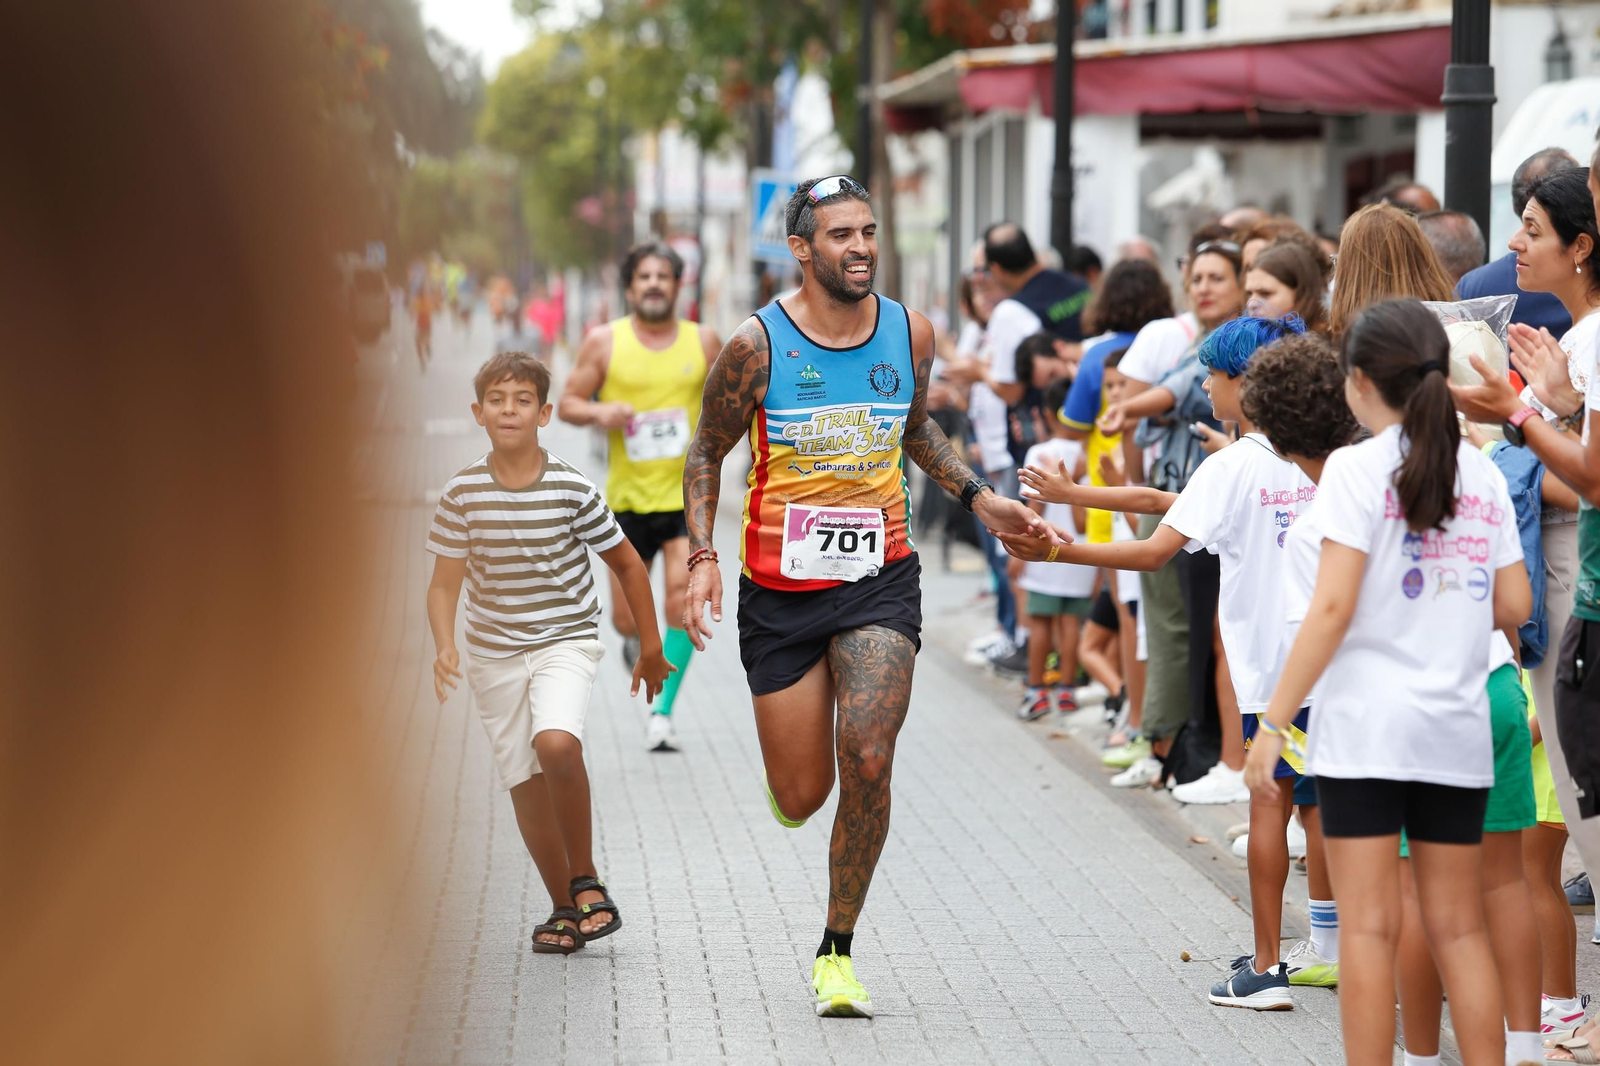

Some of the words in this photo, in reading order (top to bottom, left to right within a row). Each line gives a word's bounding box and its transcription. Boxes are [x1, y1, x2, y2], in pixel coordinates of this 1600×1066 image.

[785, 424, 813, 438] C.D.
[815, 410, 869, 434] TRAIL
[799, 433, 856, 452] TEAM
[813, 461, 856, 472] Gabarras
[858, 461, 865, 471] &
[816, 530, 877, 553] 701
